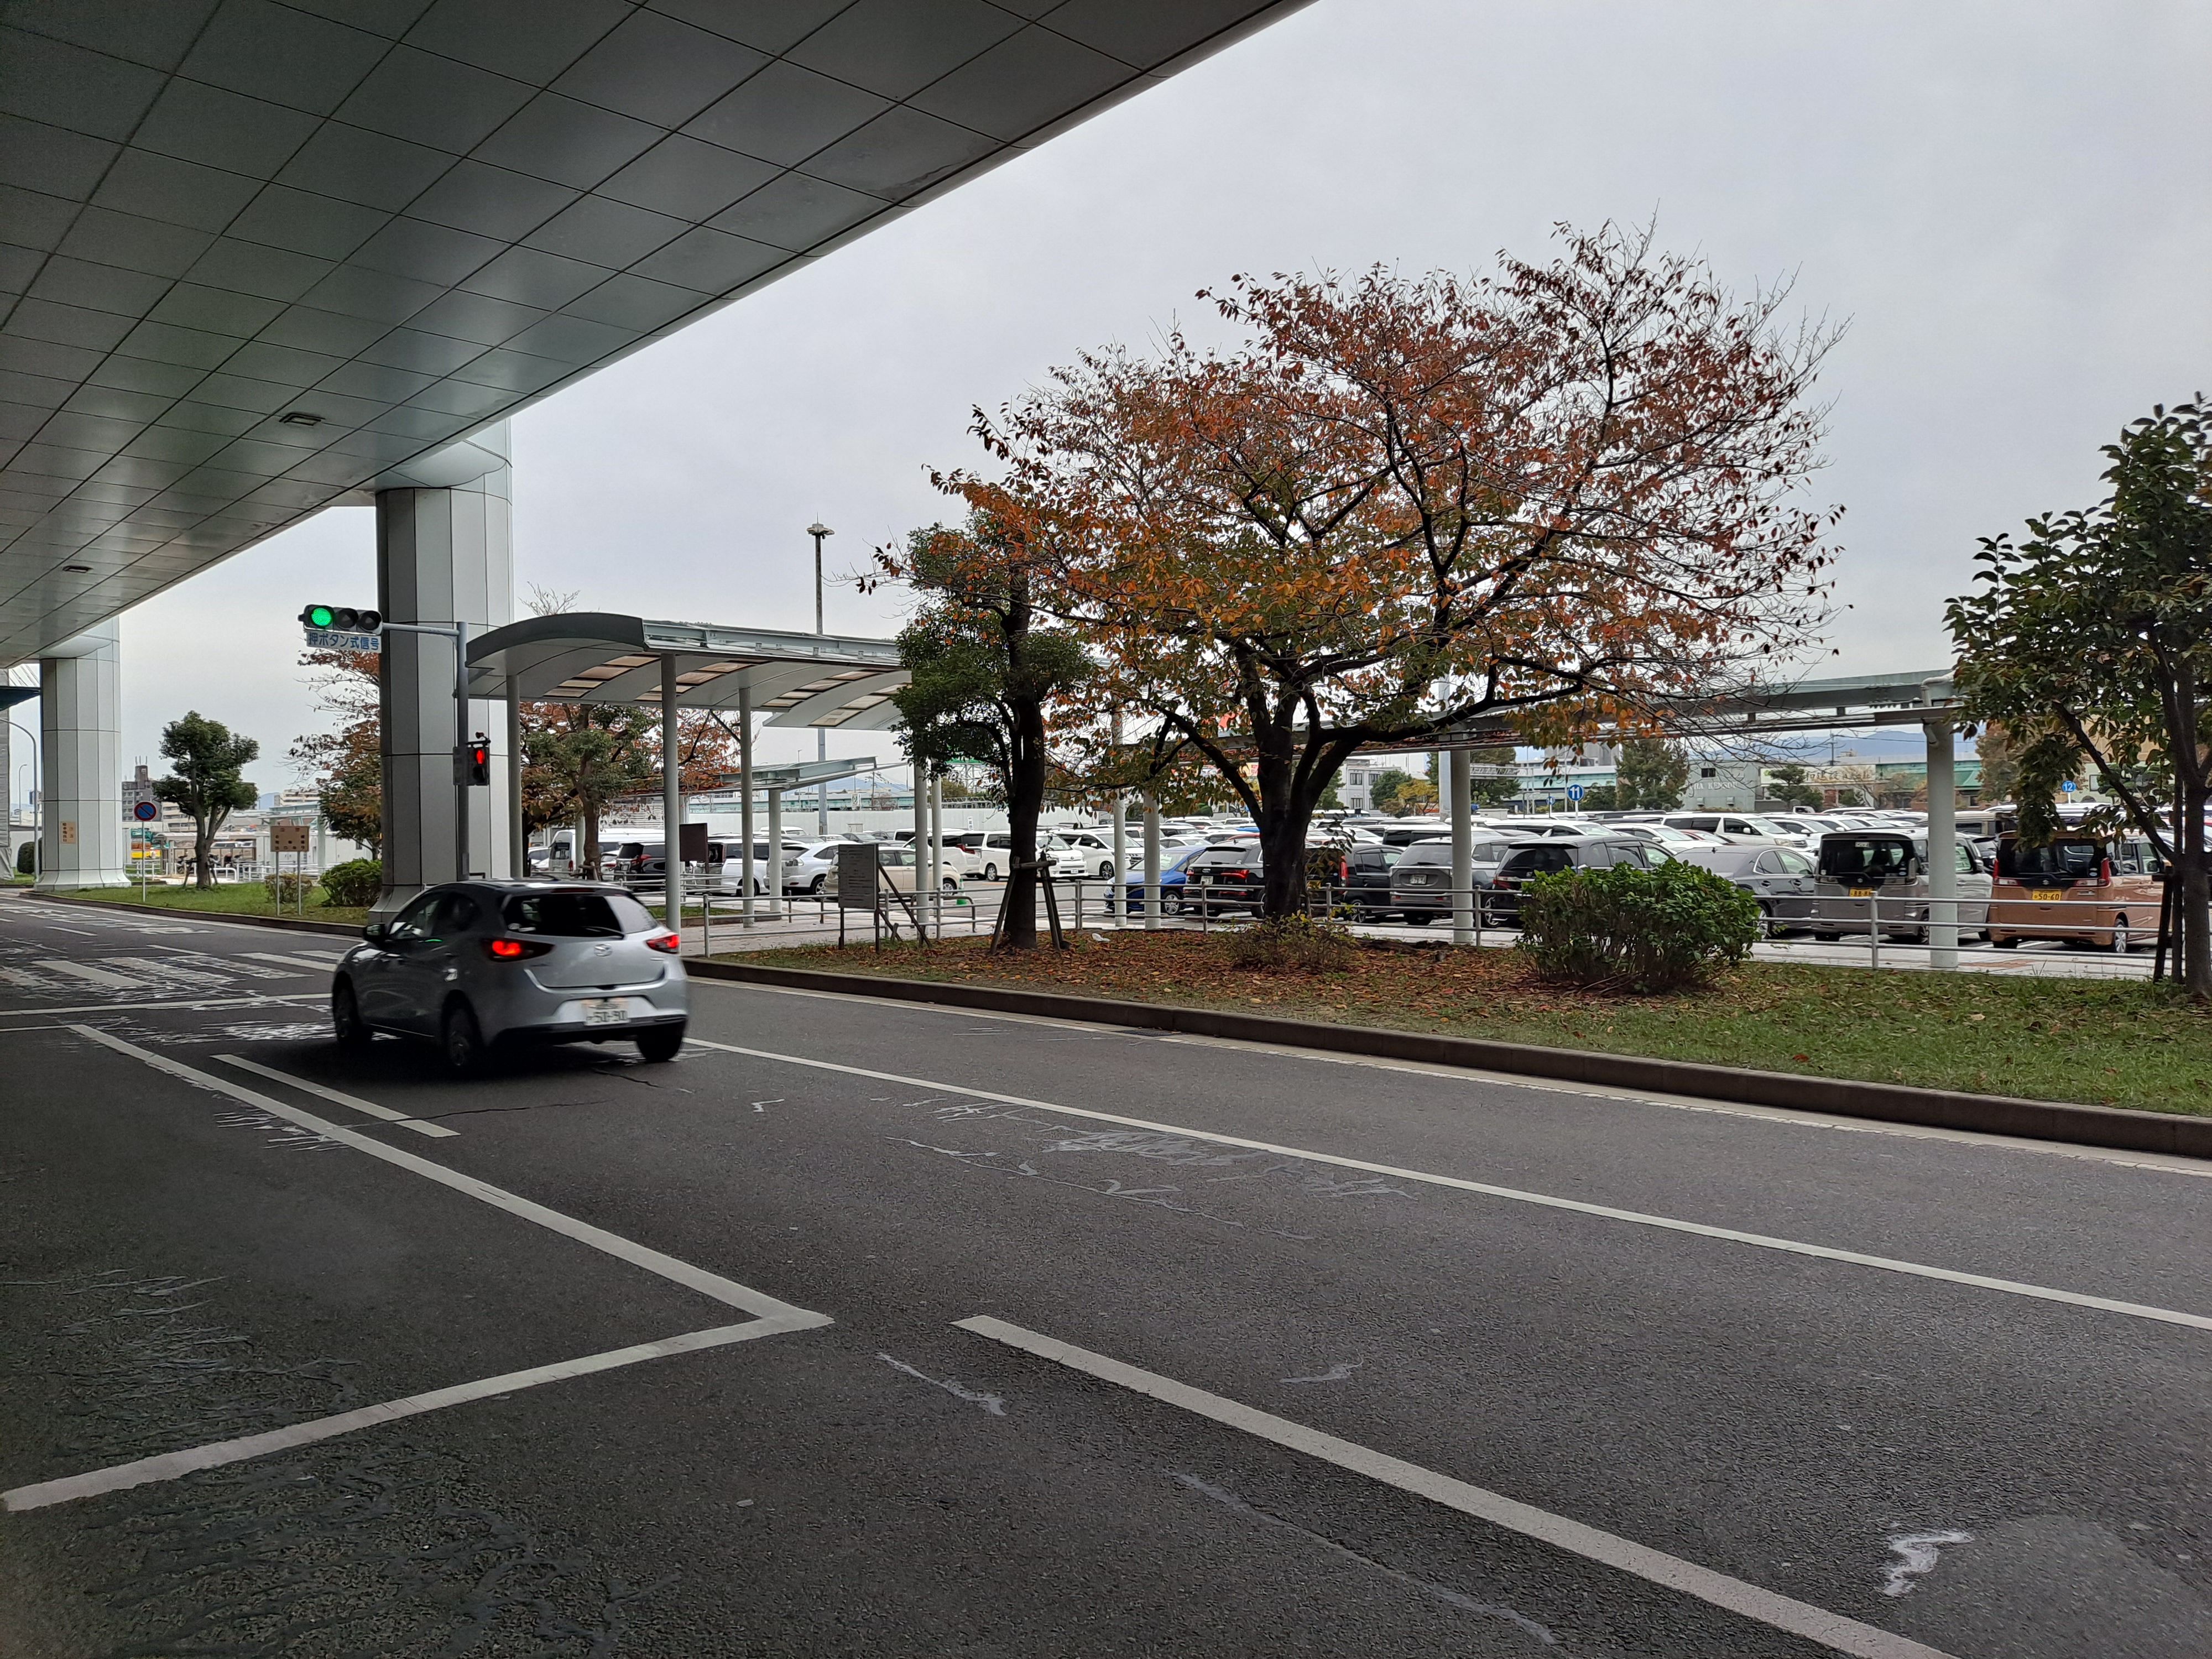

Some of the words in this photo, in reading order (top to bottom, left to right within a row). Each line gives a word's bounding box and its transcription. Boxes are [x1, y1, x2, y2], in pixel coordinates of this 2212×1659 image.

[309, 632, 379, 650] 押ボタン式信号
[1569, 786, 1580, 799] 11
[2064, 782, 2073, 791] 12
